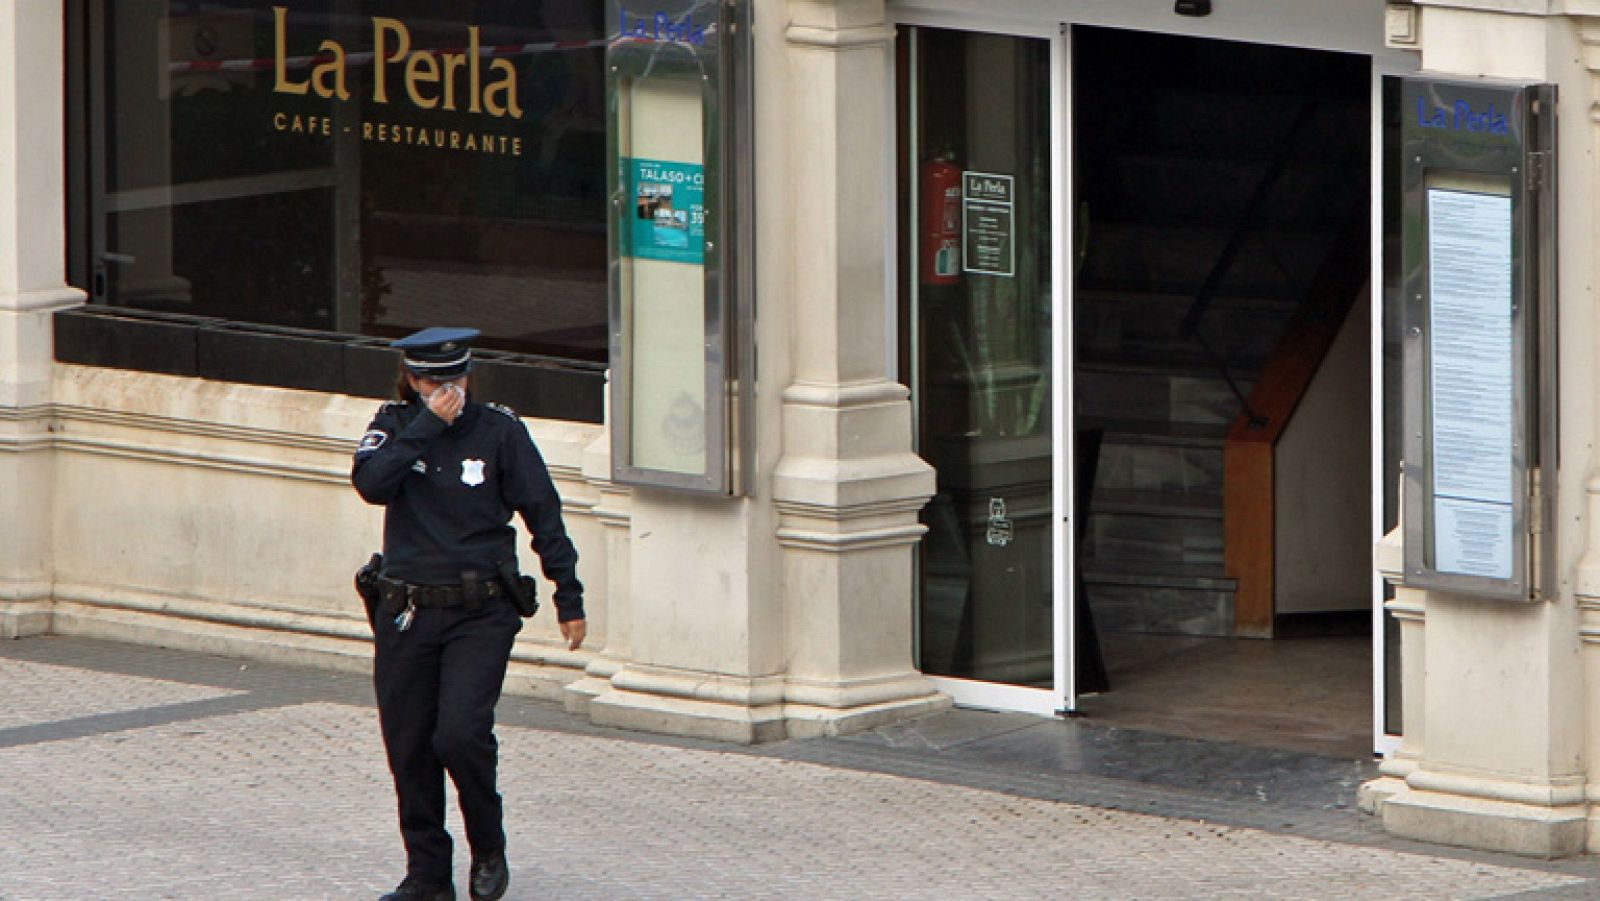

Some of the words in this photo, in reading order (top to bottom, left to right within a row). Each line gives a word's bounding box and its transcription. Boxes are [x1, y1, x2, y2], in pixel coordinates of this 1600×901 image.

[272, 5, 350, 101] La
[371, 15, 524, 119] Perla
[272, 112, 332, 137] CAFE
[363, 121, 523, 156] RESTAURANTE
[1417, 96, 1446, 128] La
[1454, 98, 1509, 135] Perla
[640, 168, 684, 184] TALASO
[970, 178, 982, 192] La
[984, 180, 1005, 195] Perla
